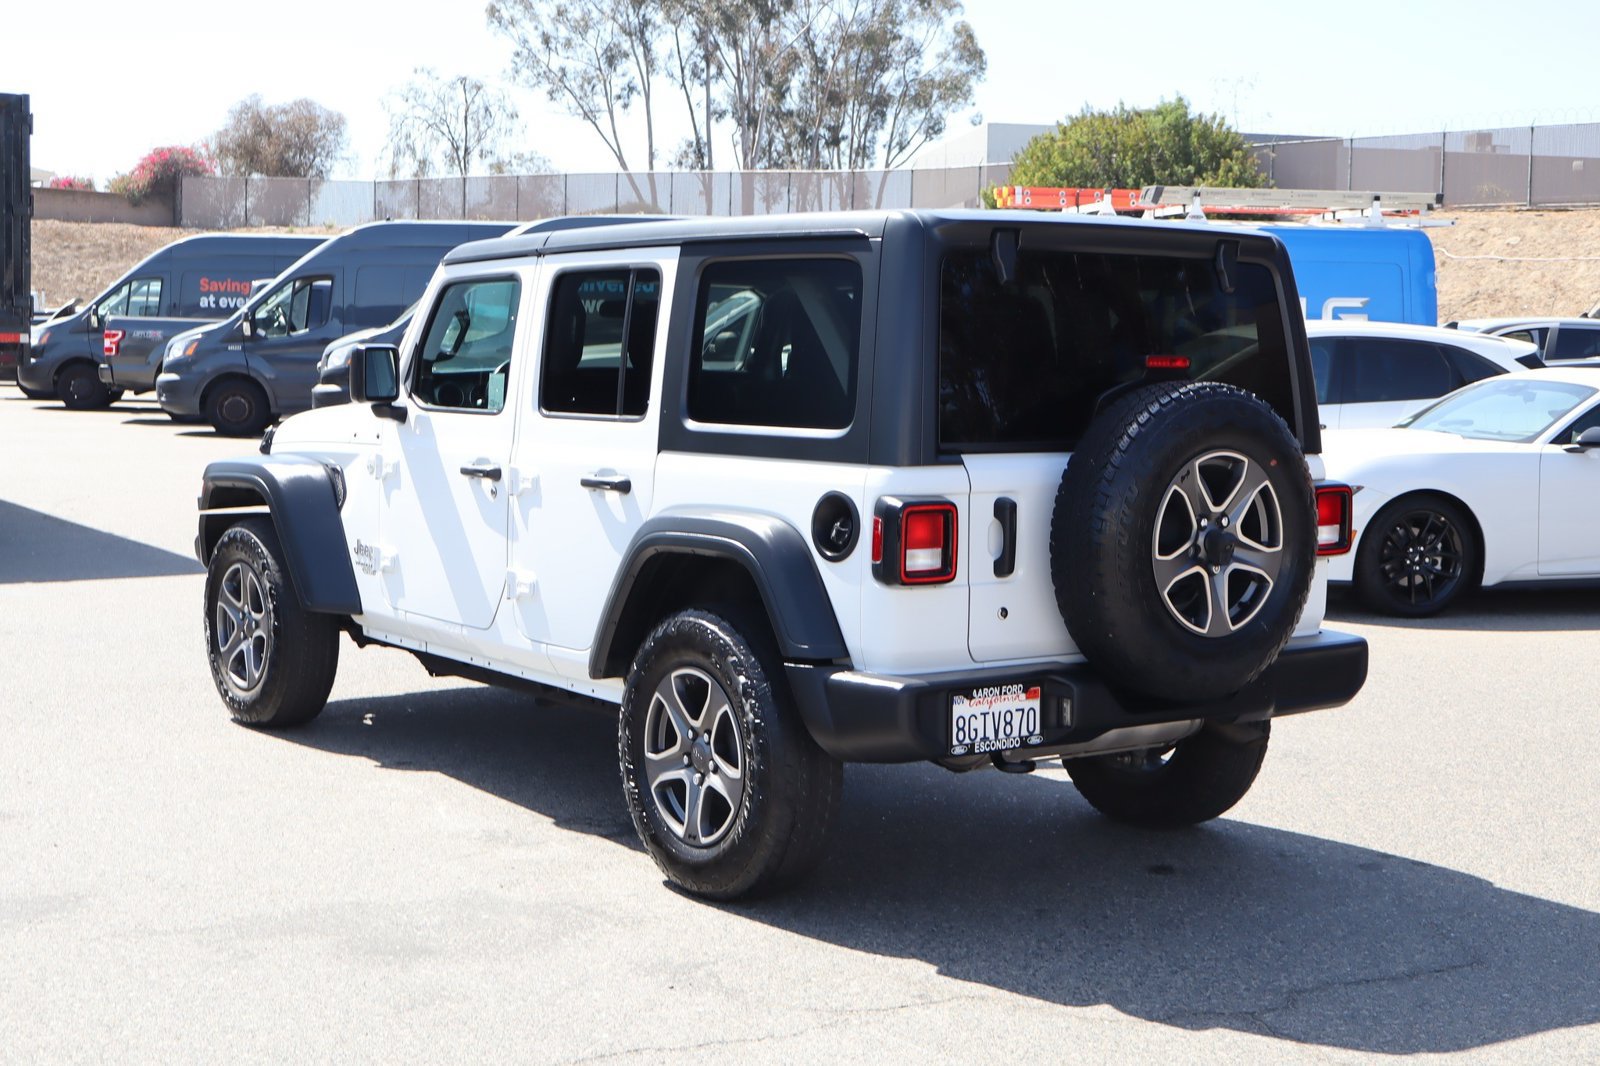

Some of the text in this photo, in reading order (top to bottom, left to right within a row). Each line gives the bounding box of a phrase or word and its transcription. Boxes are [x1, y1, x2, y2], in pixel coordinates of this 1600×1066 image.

[199, 277, 251, 295] Saving
[200, 293, 216, 308] at
[972, 686, 1000, 699] AARON
[1001, 684, 1024, 695] FORD
[955, 707, 1036, 743] 8GIV870
[974, 737, 1021, 753] ESCONDIDO
